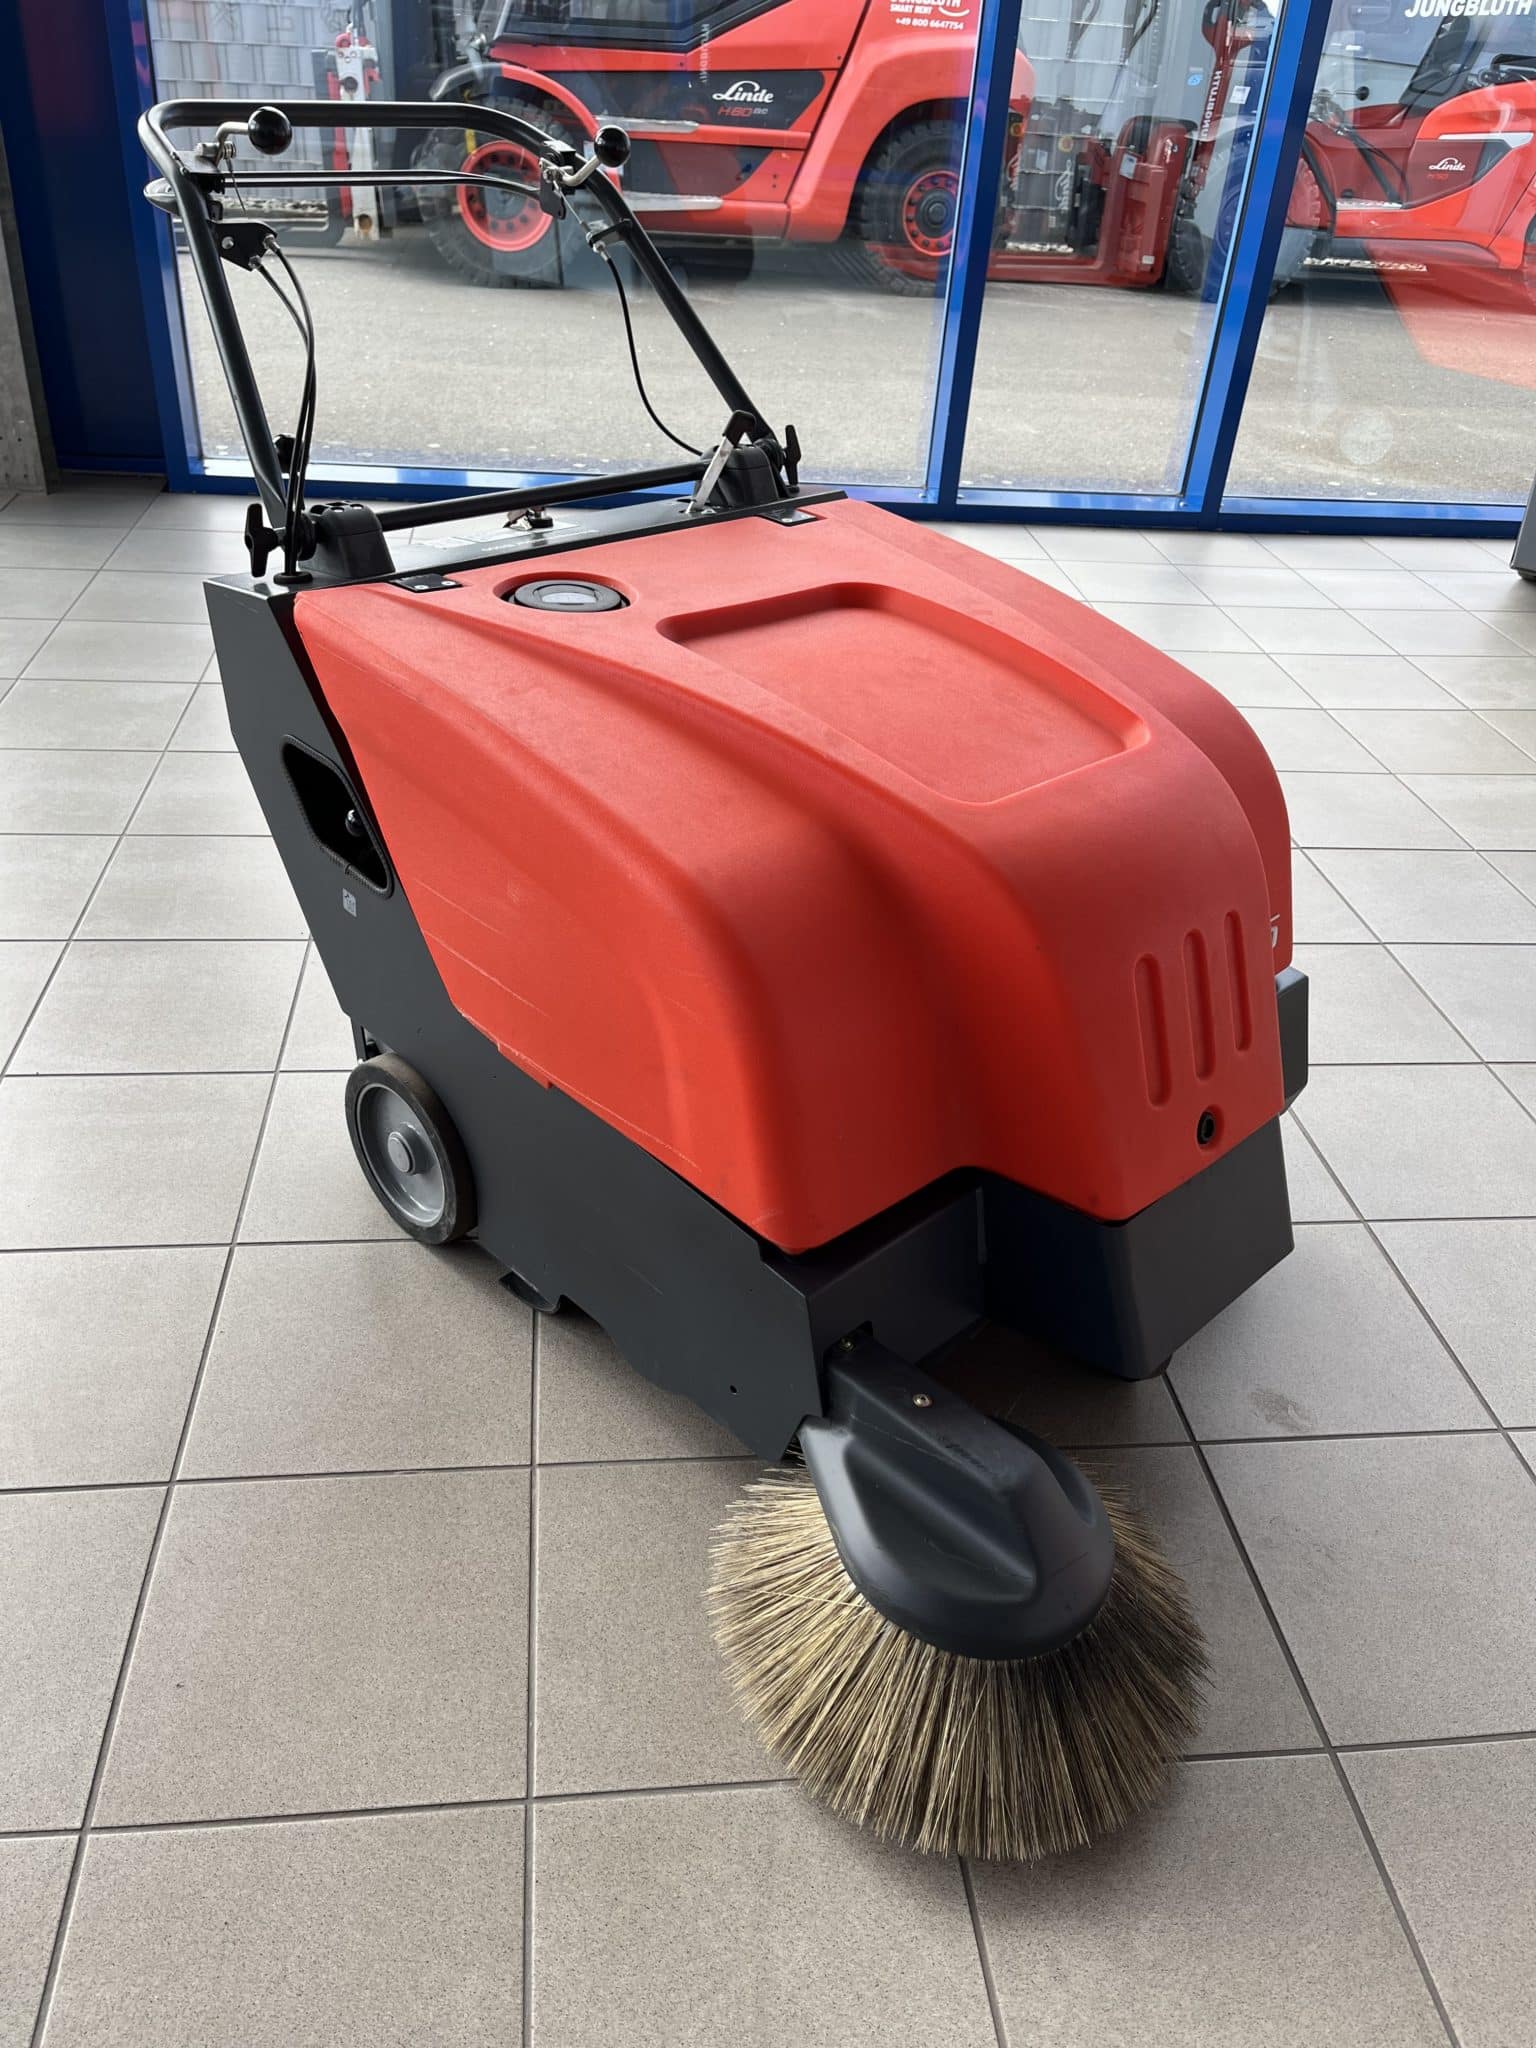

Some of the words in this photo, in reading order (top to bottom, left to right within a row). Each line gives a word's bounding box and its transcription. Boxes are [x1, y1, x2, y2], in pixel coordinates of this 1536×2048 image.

[890, 3, 913, 12] SMART
[914, 5, 932, 14] RENT
[1405, 0, 1532, 17] JUNGBLUTH
[912, 18, 928, 27] 800
[712, 80, 774, 103] Linde
[1428, 157, 1466, 171] Linde
